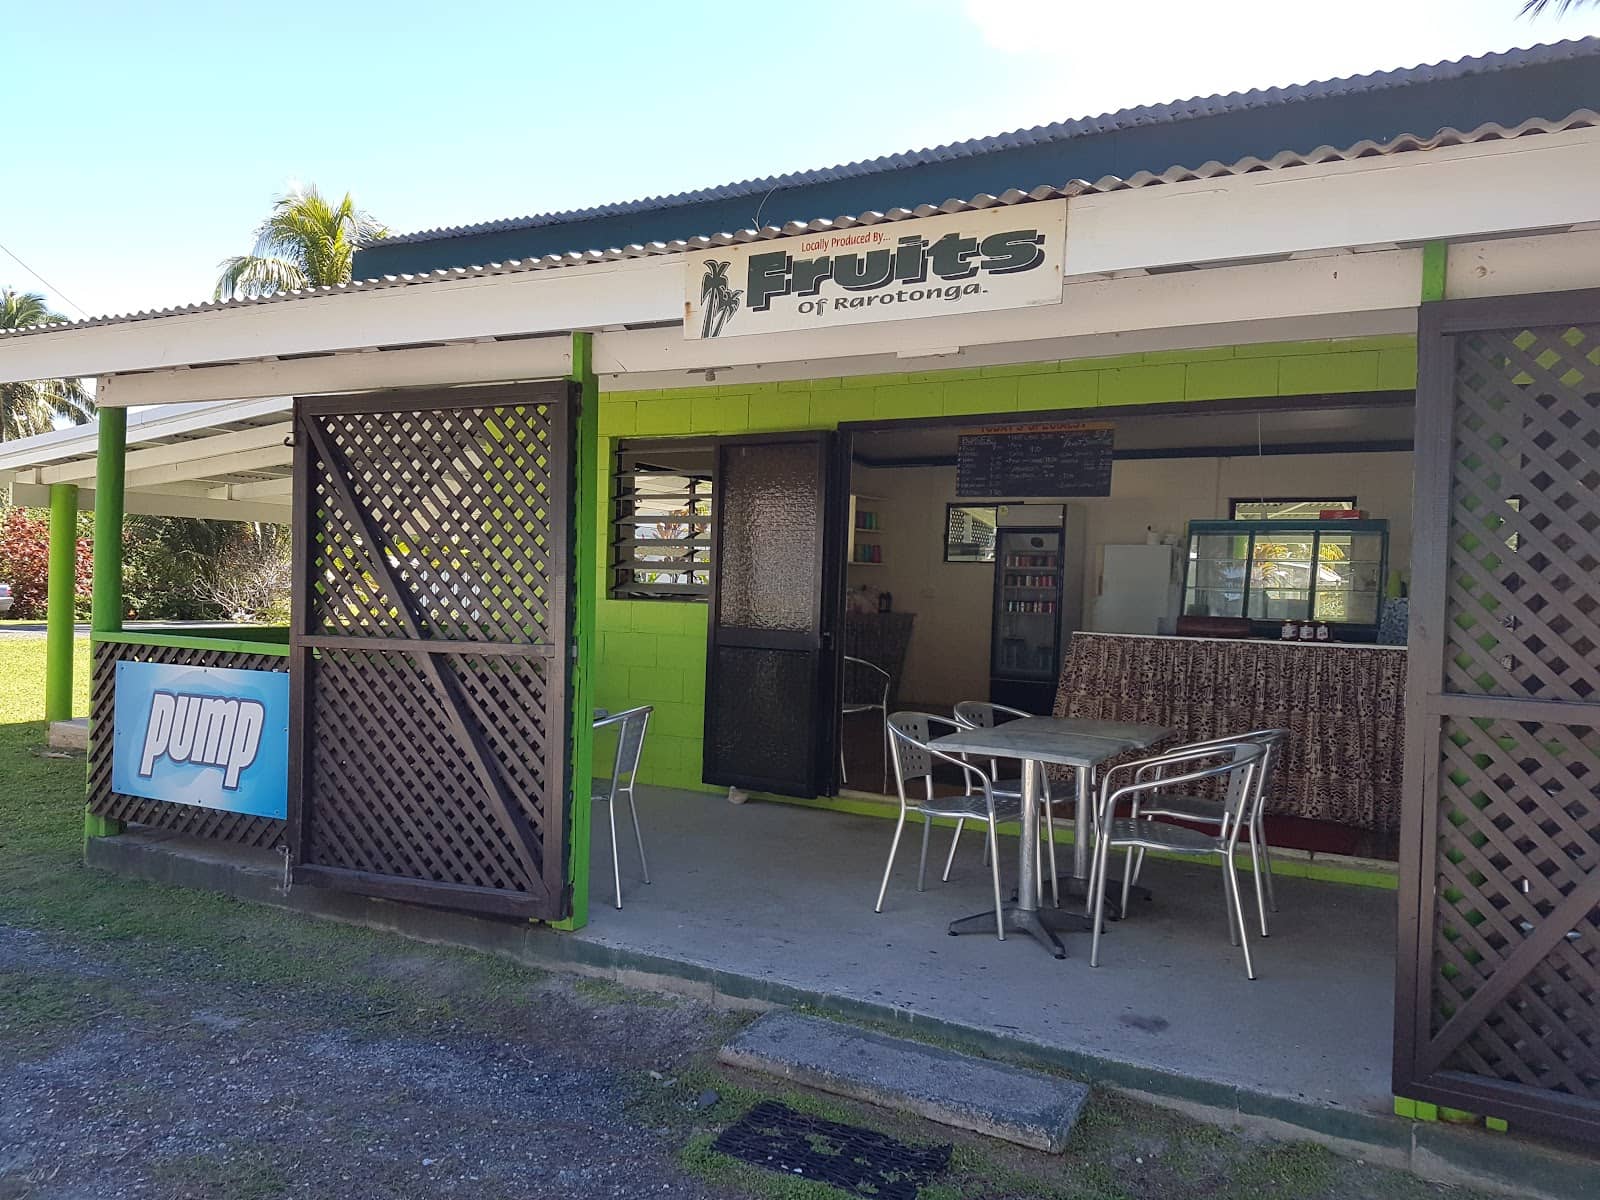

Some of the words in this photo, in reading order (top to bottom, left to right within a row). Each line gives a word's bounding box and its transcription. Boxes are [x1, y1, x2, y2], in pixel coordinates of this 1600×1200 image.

[801, 237, 830, 253] Locally
[831, 232, 871, 249] Produced
[871, 231, 891, 245] By...
[746, 229, 1046, 313] Fruits
[797, 300, 828, 317] Of
[834, 282, 988, 311] Rarotonga.
